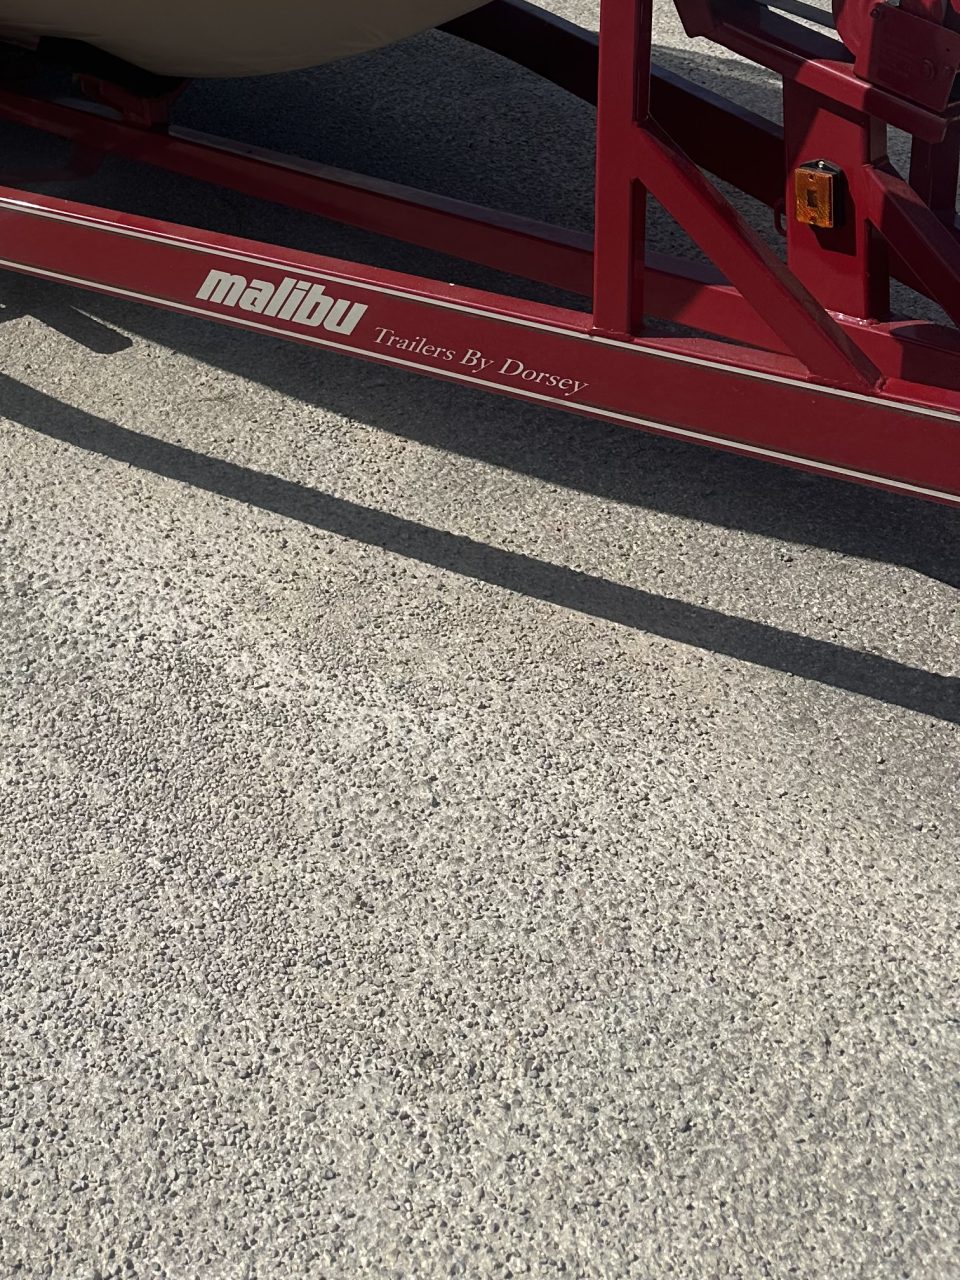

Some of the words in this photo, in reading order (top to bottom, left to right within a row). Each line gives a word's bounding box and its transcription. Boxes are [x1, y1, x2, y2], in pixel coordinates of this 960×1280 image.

[195, 269, 368, 336] malibu
[373, 327, 455, 362] Trailers
[460, 349, 495, 373] By
[498, 358, 589, 396] Dorsey
